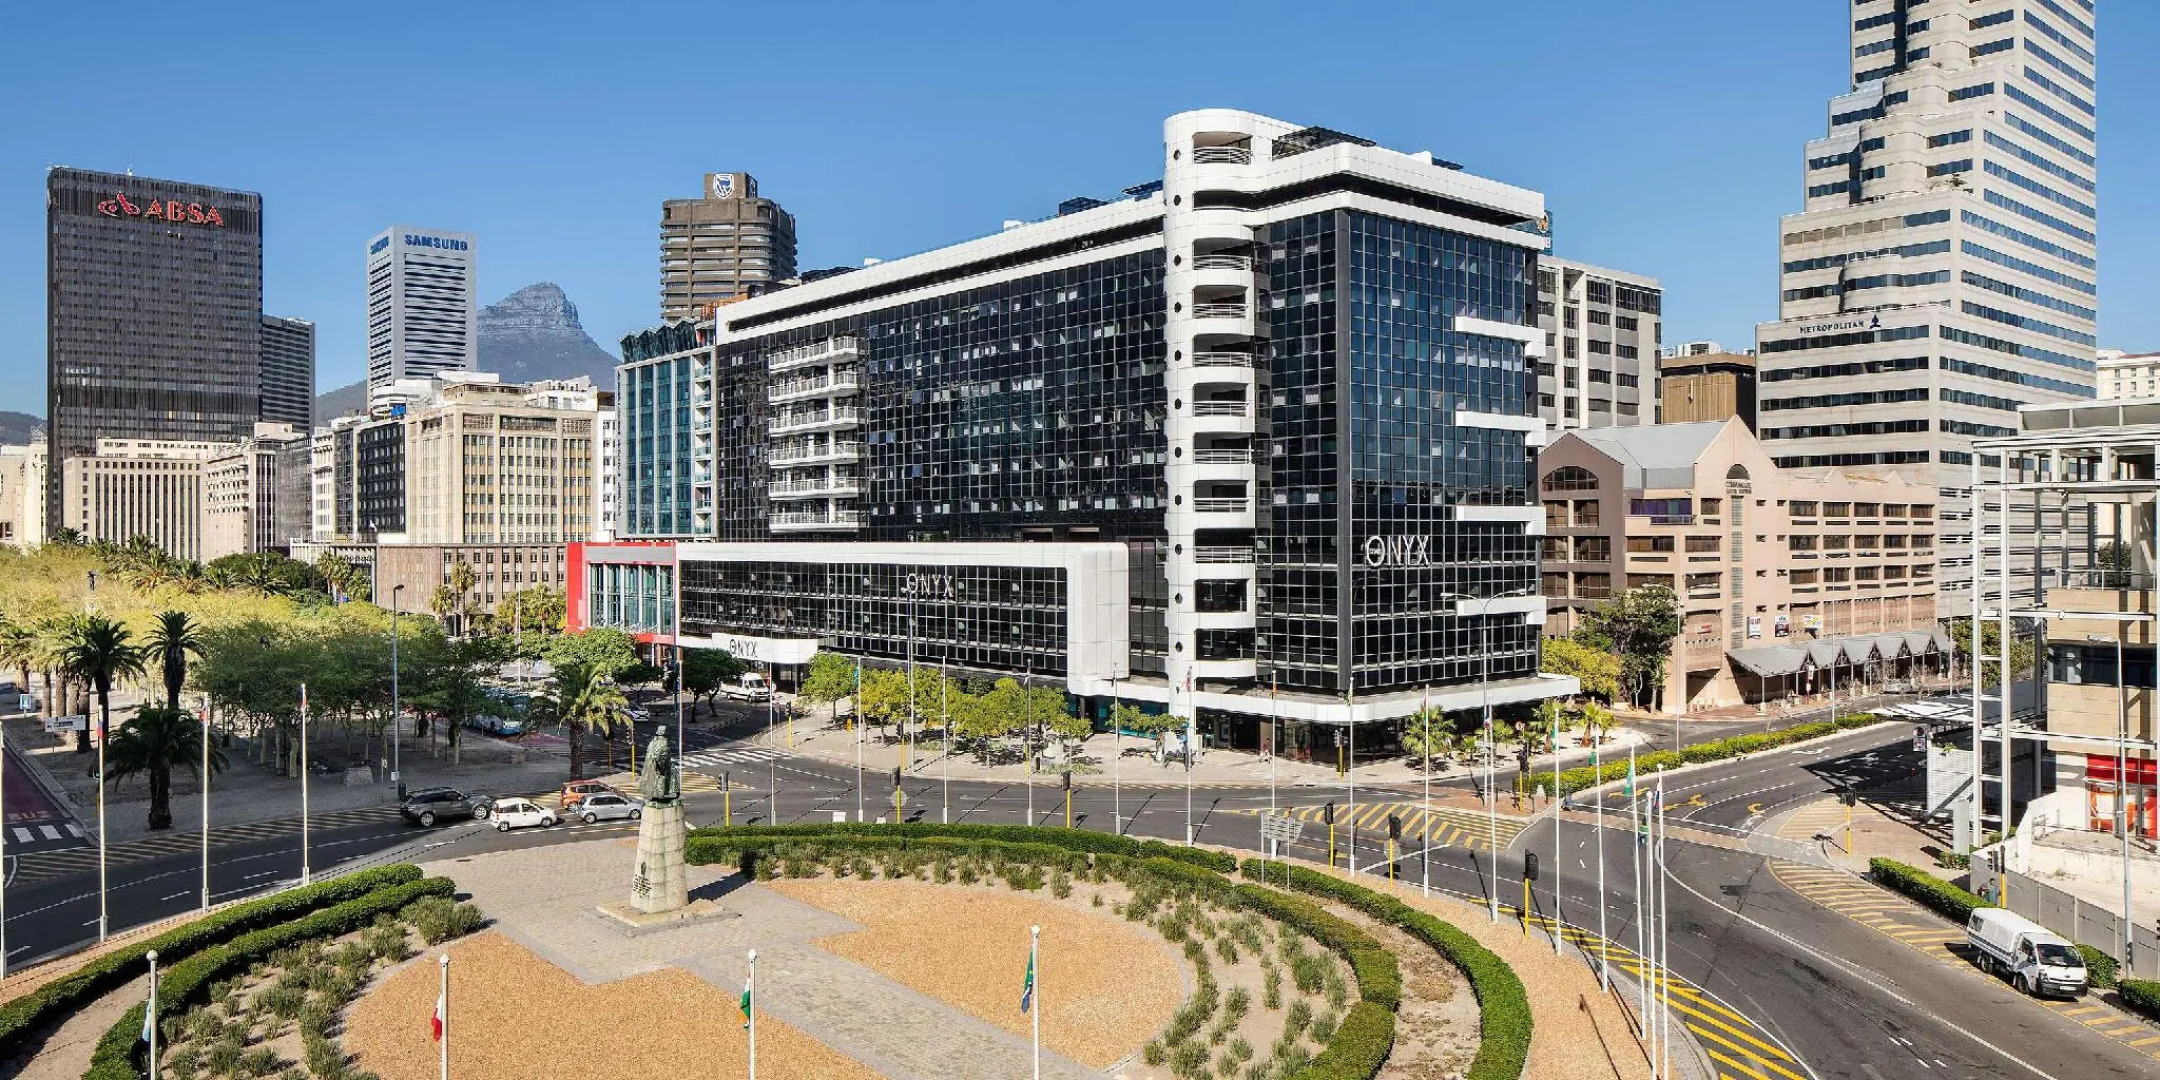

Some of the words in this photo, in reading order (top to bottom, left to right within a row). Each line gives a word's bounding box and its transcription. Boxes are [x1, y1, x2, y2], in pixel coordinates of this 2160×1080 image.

[145, 199, 224, 227] ABSA
[404, 233, 468, 252] SAMSUNG
[1799, 320, 1864, 334] METROPOLITAN
[1366, 535, 1430, 567] ONYX
[906, 573, 954, 598] ONYX
[730, 638, 758, 657] ONYX
